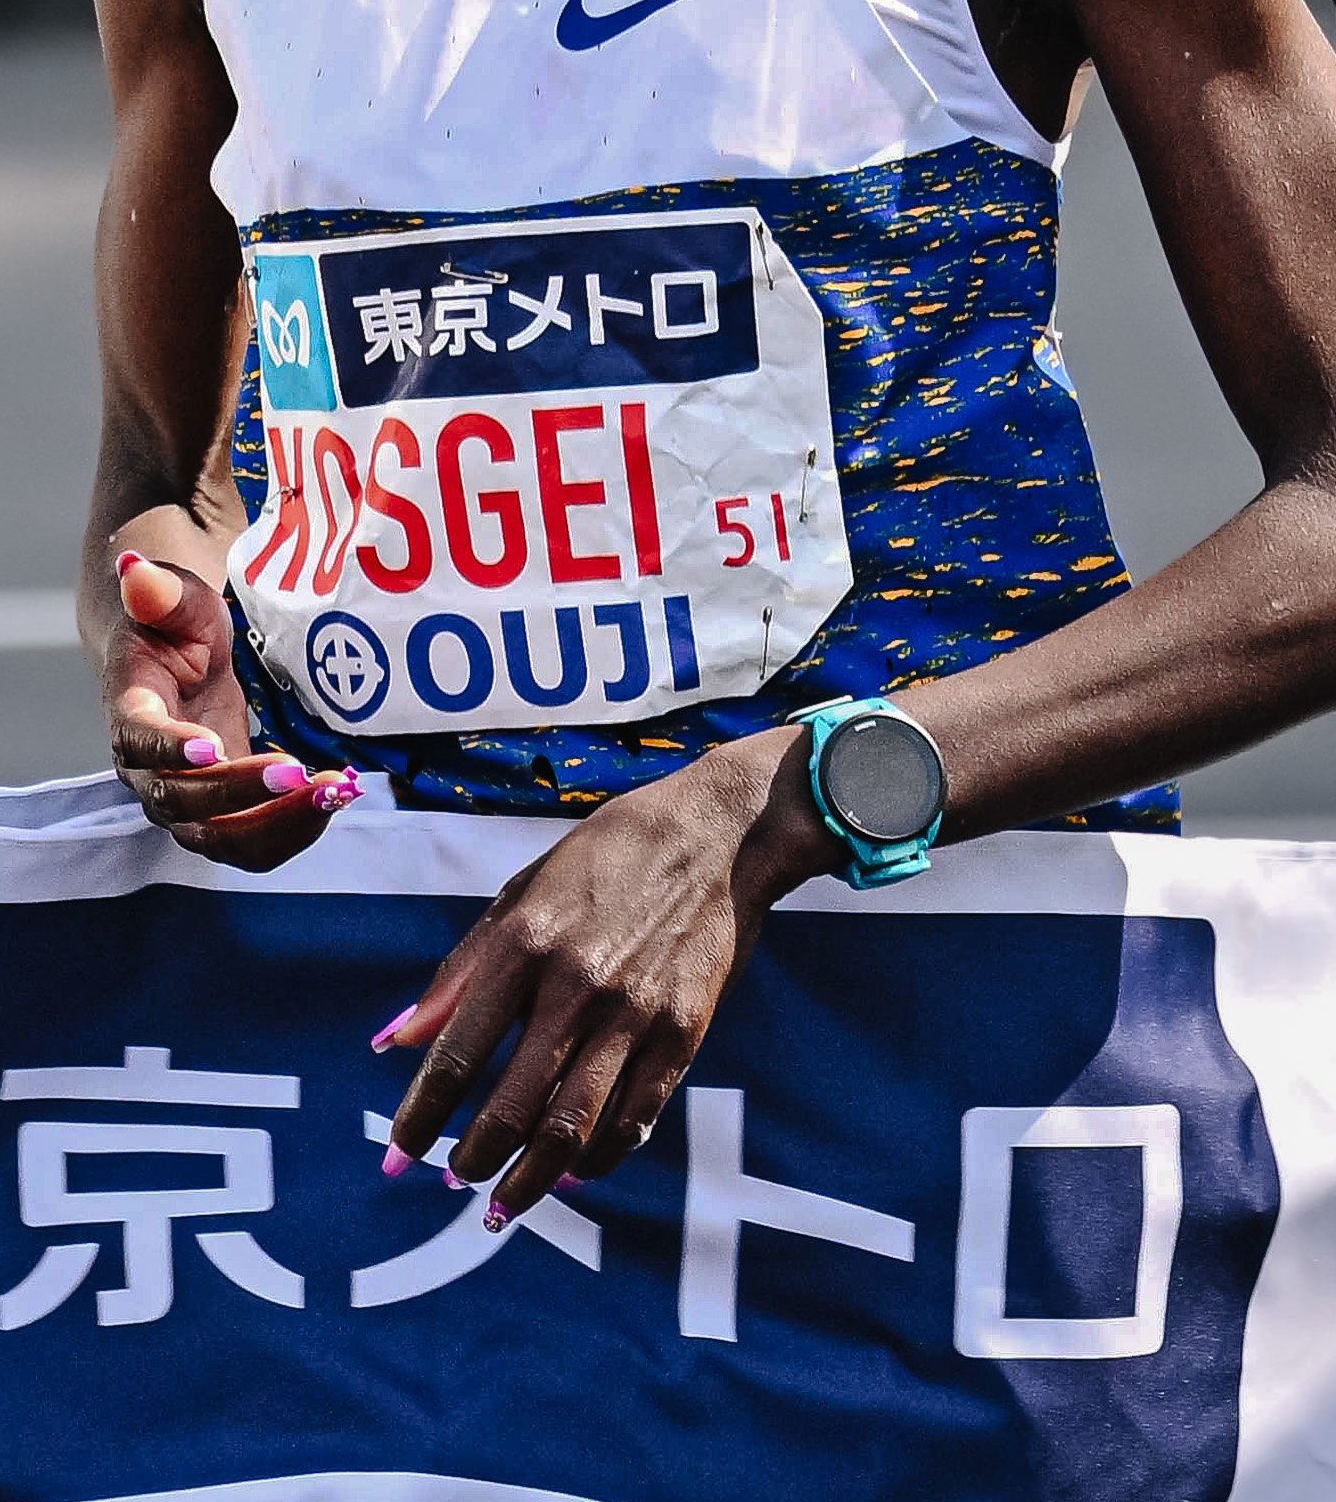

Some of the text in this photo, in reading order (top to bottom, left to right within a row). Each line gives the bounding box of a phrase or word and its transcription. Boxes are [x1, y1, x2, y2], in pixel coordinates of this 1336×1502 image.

[351, 269, 720, 366] 東京メトロ
[244, 401, 664, 597] KOSGEI
[714, 491, 791, 568] 51
[405, 593, 703, 714] OUJI
